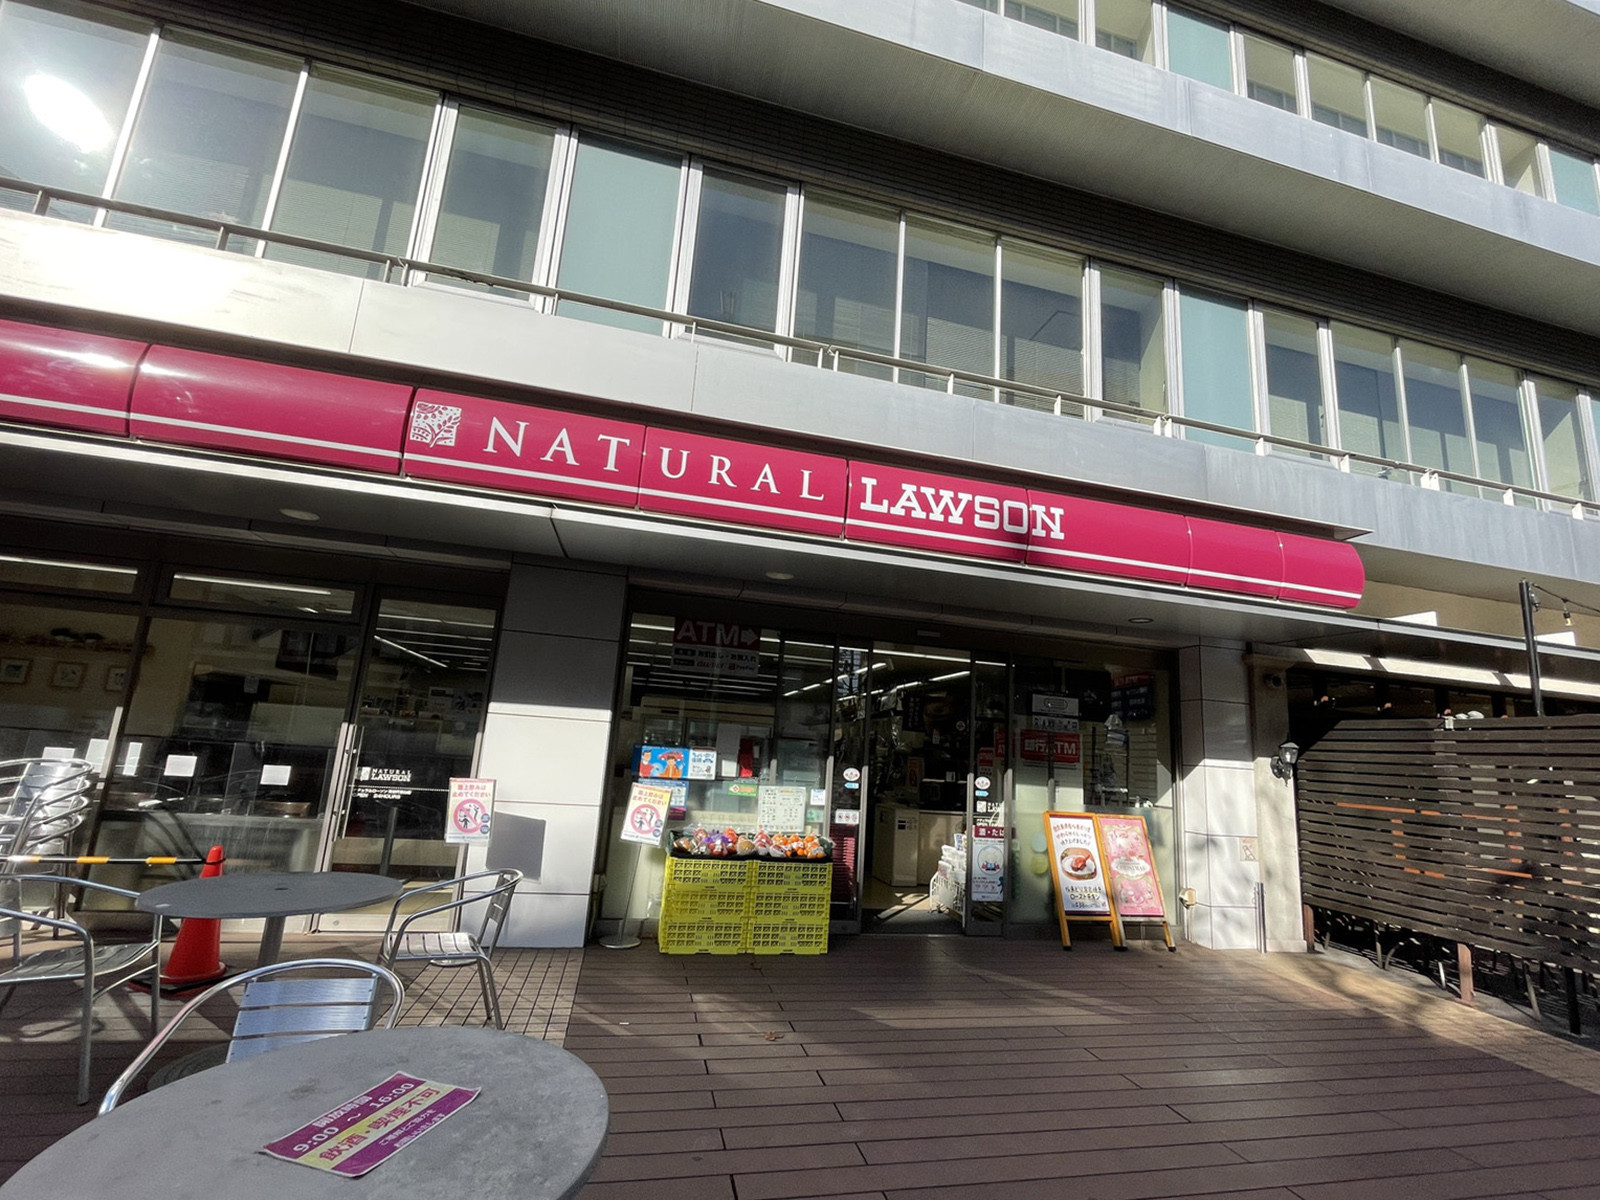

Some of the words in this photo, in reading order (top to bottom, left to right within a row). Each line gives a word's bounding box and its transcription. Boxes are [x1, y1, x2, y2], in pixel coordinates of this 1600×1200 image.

[483, 415, 825, 502] NATURAL
[859, 475, 1066, 542] LAWSON
[675, 619, 740, 647] ATM
[370, 773, 411, 782] LAWSON
[293, 1126, 340, 1153] 9:00
[369, 1082, 415, 1109] 16:00
[318, 1087, 441, 1161] 飲酒・喫煙不可
